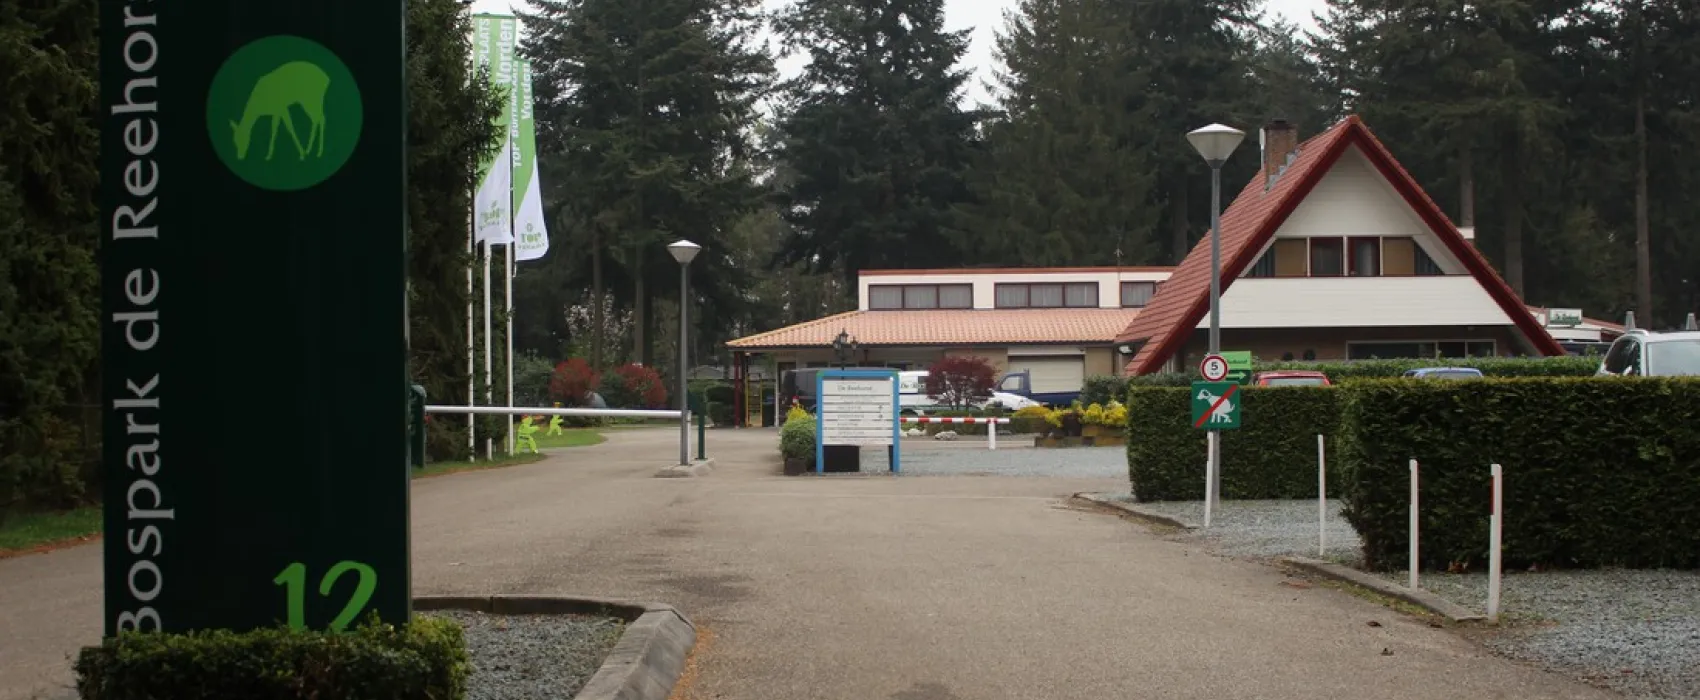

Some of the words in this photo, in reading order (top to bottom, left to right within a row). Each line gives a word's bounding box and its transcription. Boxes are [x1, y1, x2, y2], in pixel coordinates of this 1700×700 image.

[496, 19, 512, 85] Vorden
[111, 0, 160, 240] Reehor
[521, 63, 530, 119] Vorden
[512, 142, 522, 168] TOP
[112, 267, 160, 350] de
[1211, 362, 1219, 371] 5
[113, 373, 175, 633] Bospark
[273, 560, 378, 635] 12
